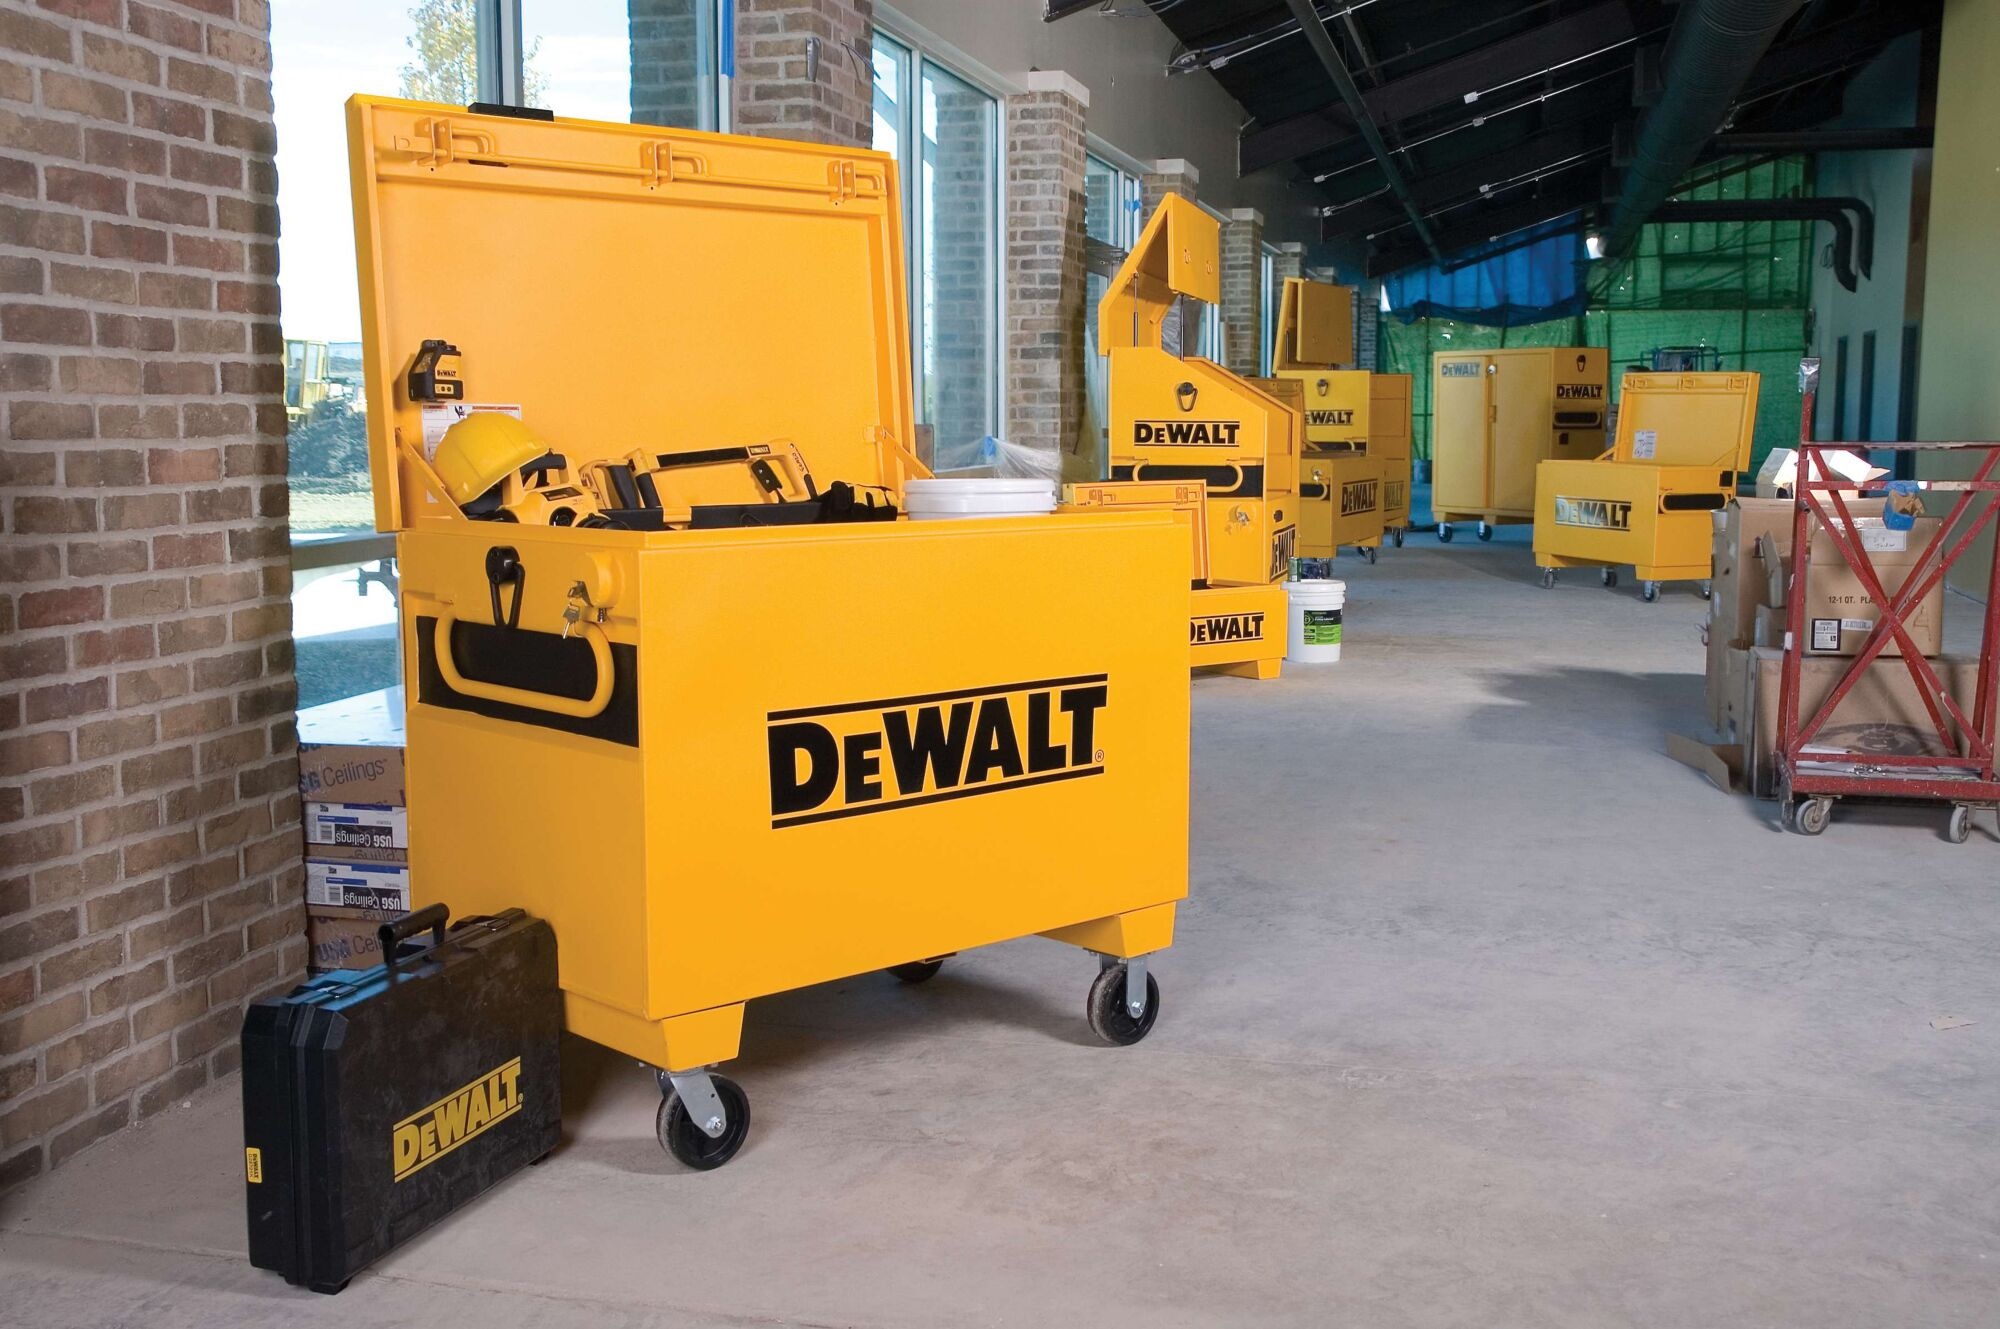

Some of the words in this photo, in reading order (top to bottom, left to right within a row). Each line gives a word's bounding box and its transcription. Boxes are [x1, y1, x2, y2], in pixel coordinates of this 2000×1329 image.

[1556, 385, 1602, 398] DEWALT
[1133, 423, 1240, 444] DEWALT
[1556, 497, 1631, 528] DEWALT
[1828, 596, 1842, 604] 12-1
[767, 685, 1108, 816] DEWALT
[373, 835, 392, 848] USG
[382, 897, 400, 910] USG
[393, 1062, 521, 1175] DEWALT
